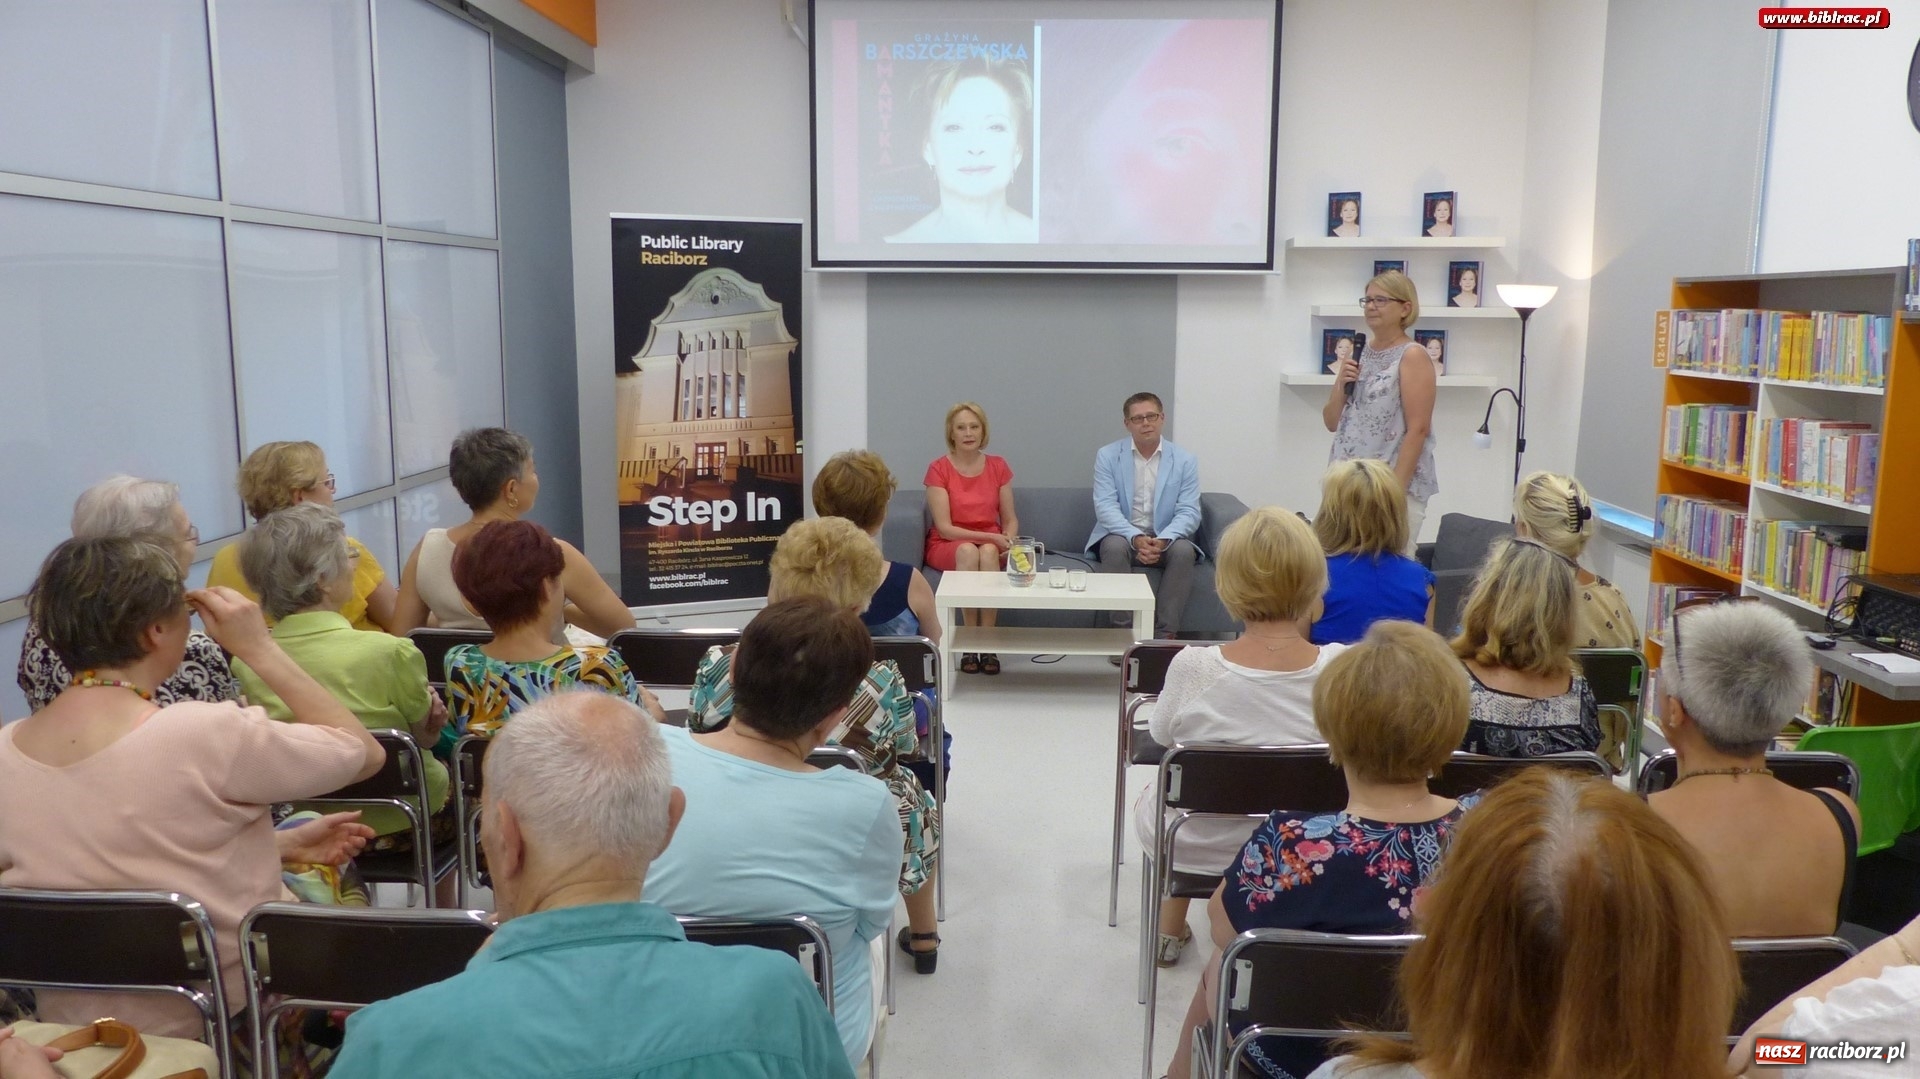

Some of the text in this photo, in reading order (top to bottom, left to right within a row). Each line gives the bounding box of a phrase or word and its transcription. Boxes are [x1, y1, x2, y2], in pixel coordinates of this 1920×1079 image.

[914, 32, 980, 42] GRAŻYNA
[865, 43, 1029, 61] BARSZCZEWSKA
[640, 235, 744, 253] Public Library
[641, 251, 708, 266] Raciborz
[1656, 314, 1668, 363] 12-14 LAT
[647, 491, 781, 532] Step In
[648, 541, 674, 549] Miejska
[678, 539, 715, 547] Powiatowa
[715, 537, 749, 545] Biblioteka
[648, 572, 706, 582] www.biblrac.pl
[649, 578, 729, 590] facebook.com/biblrac
